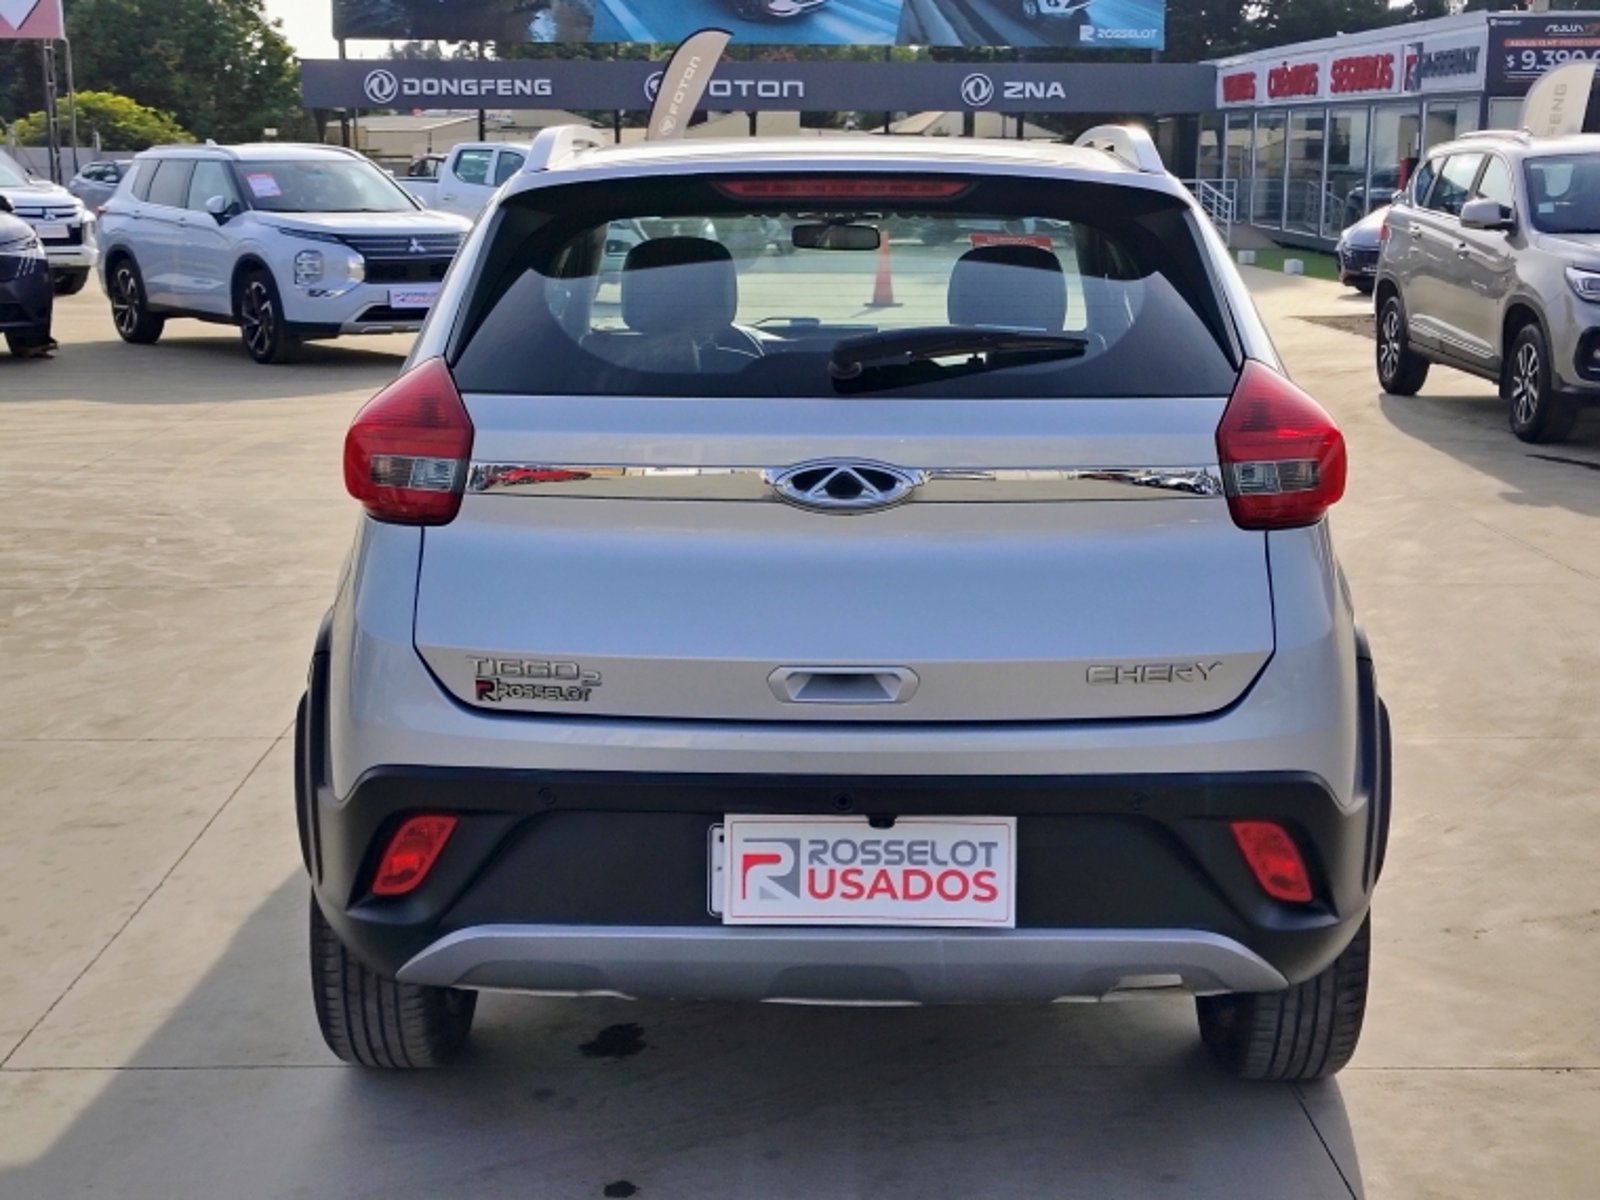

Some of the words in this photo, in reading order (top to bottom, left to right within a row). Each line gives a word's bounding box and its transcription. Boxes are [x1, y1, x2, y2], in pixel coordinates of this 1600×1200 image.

[1098, 29, 1157, 39] ROSSELOT
[403, 78, 552, 95] DONGFENG
[669, 56, 702, 115] FOTON
[709, 79, 805, 97] OTON
[1003, 81, 1066, 99] ZNA
[466, 656, 579, 680] TIGGO
[581, 670, 602, 686] 2
[1086, 661, 1223, 684] CHERY
[499, 683, 592, 702] ROSSELOT
[808, 839, 999, 867] ROSSELOT
[807, 867, 999, 903] USADOS
